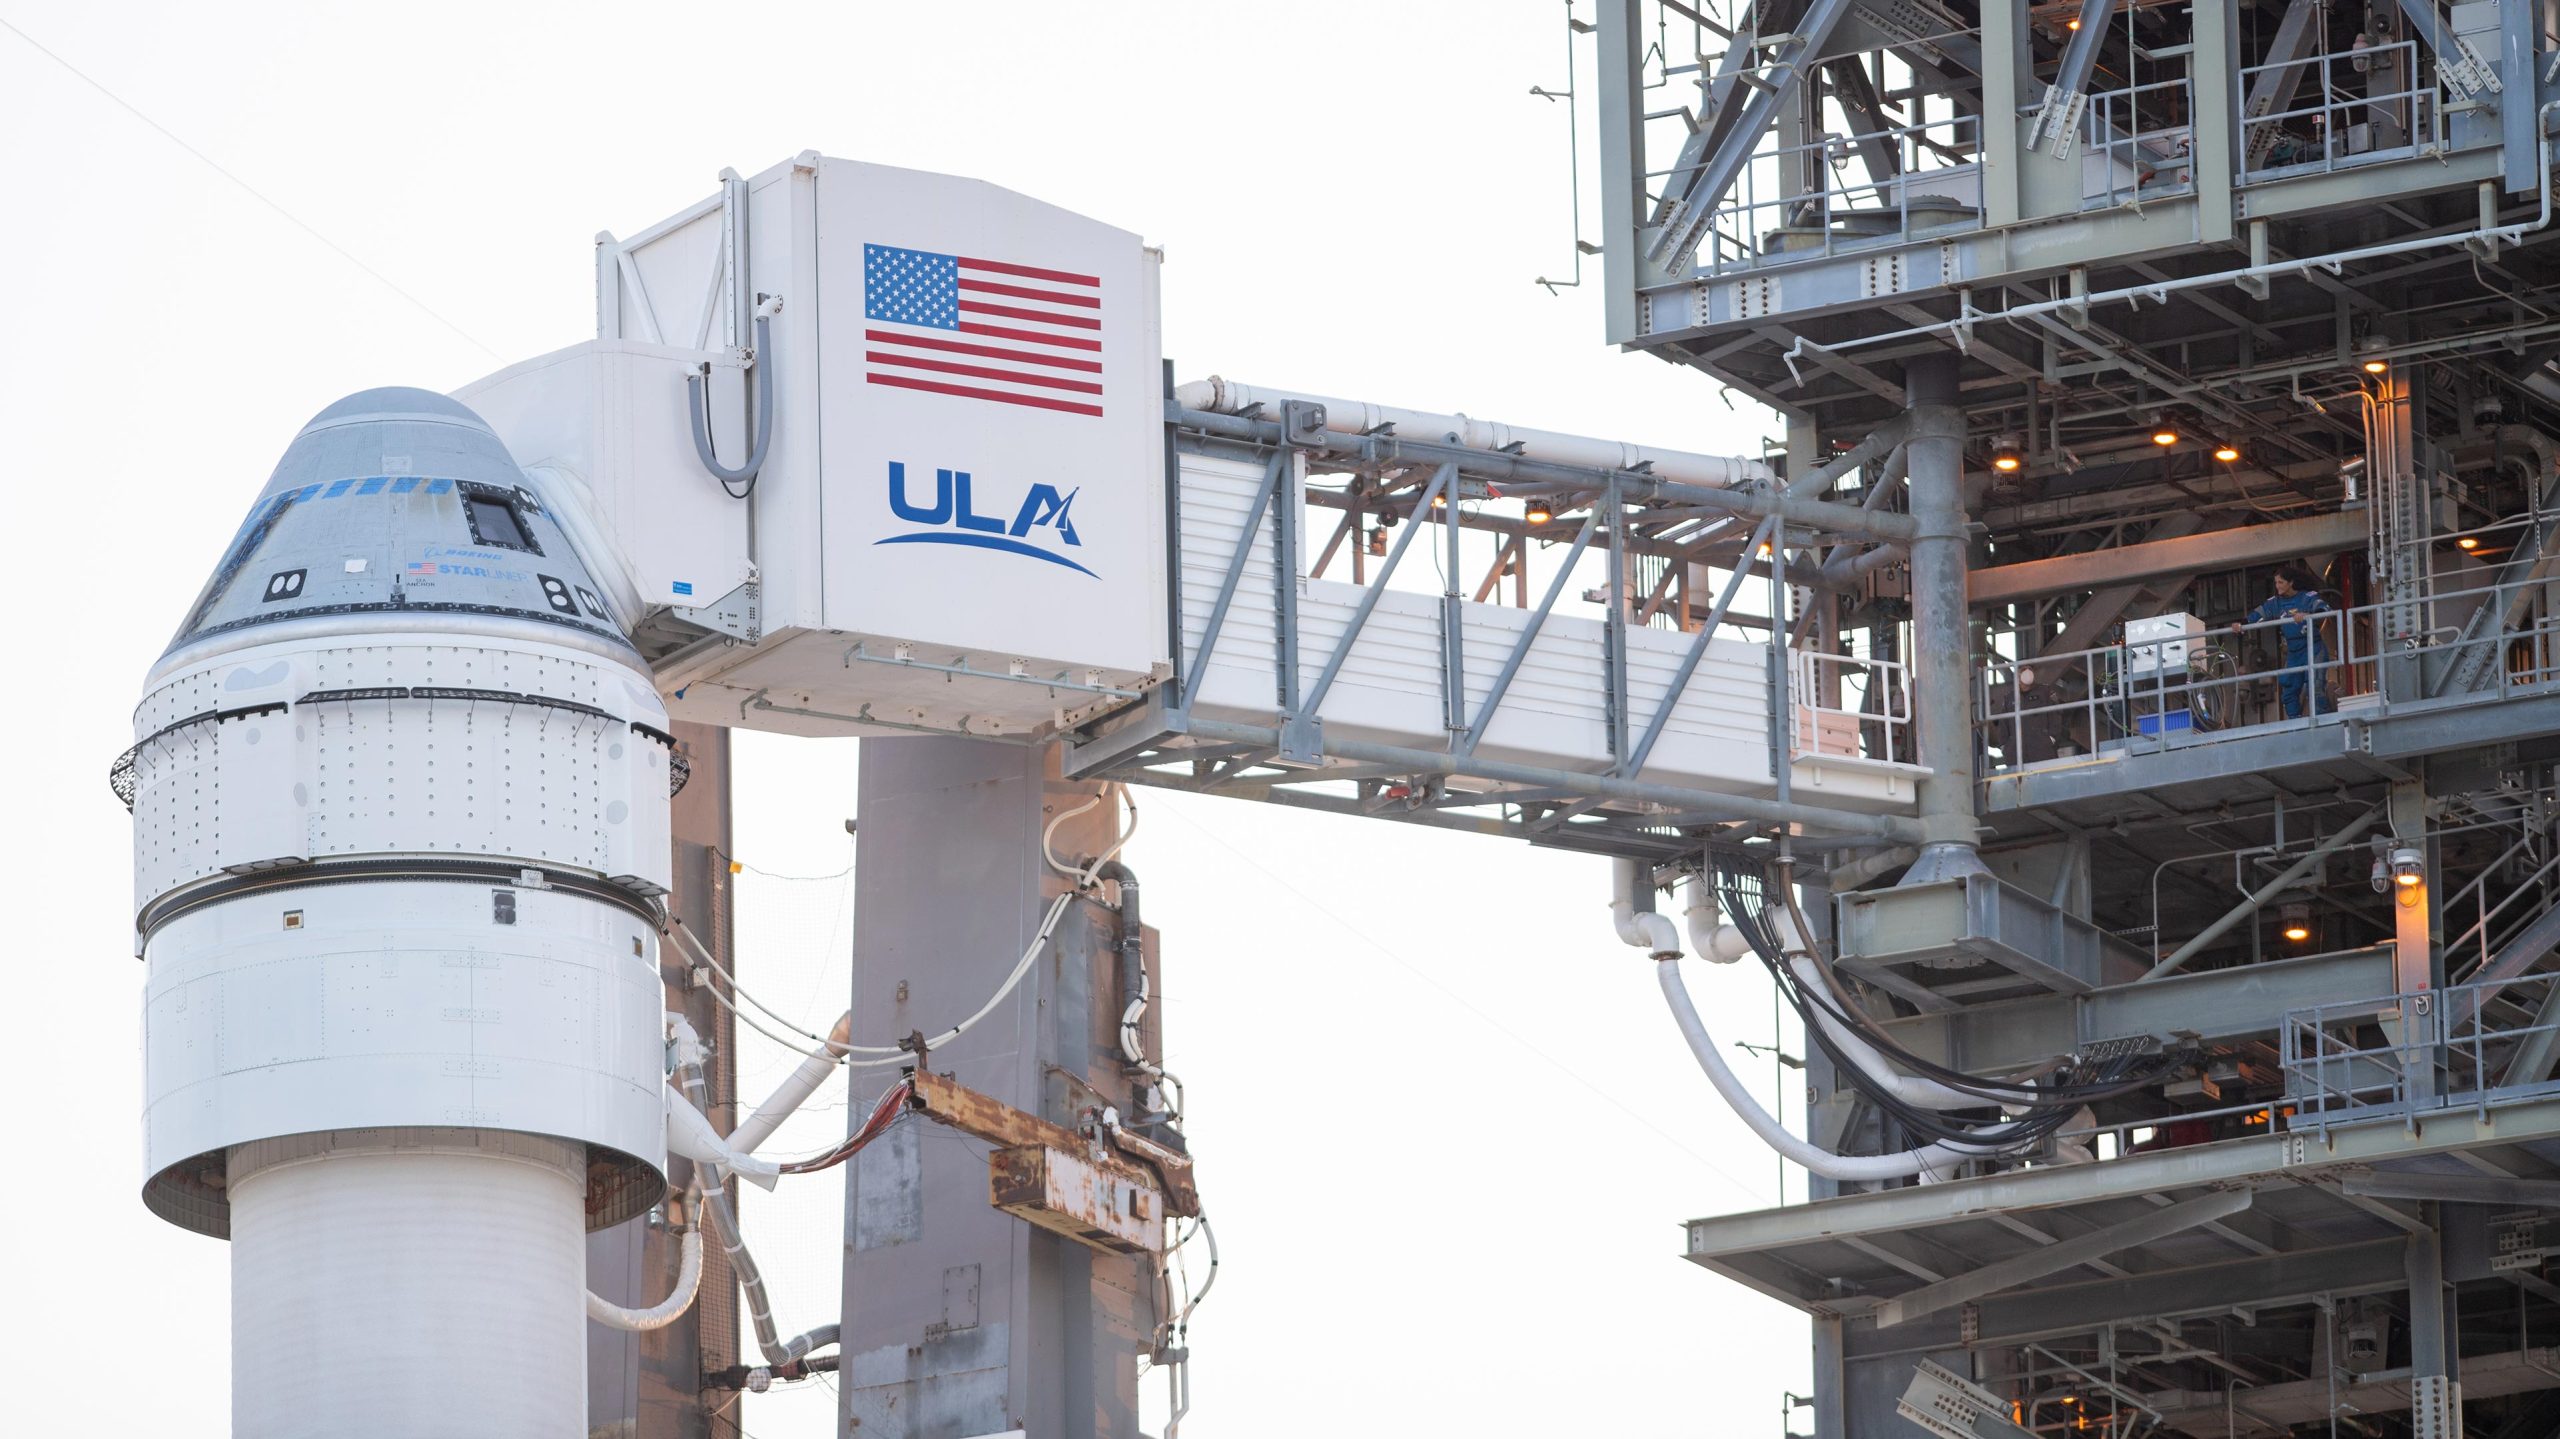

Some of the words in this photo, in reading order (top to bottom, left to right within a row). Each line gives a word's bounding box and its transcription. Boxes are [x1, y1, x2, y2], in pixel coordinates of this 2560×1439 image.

[888, 460, 1081, 546] ULA
[445, 549, 503, 560] BOEING
[438, 564, 528, 581] STARLINER
